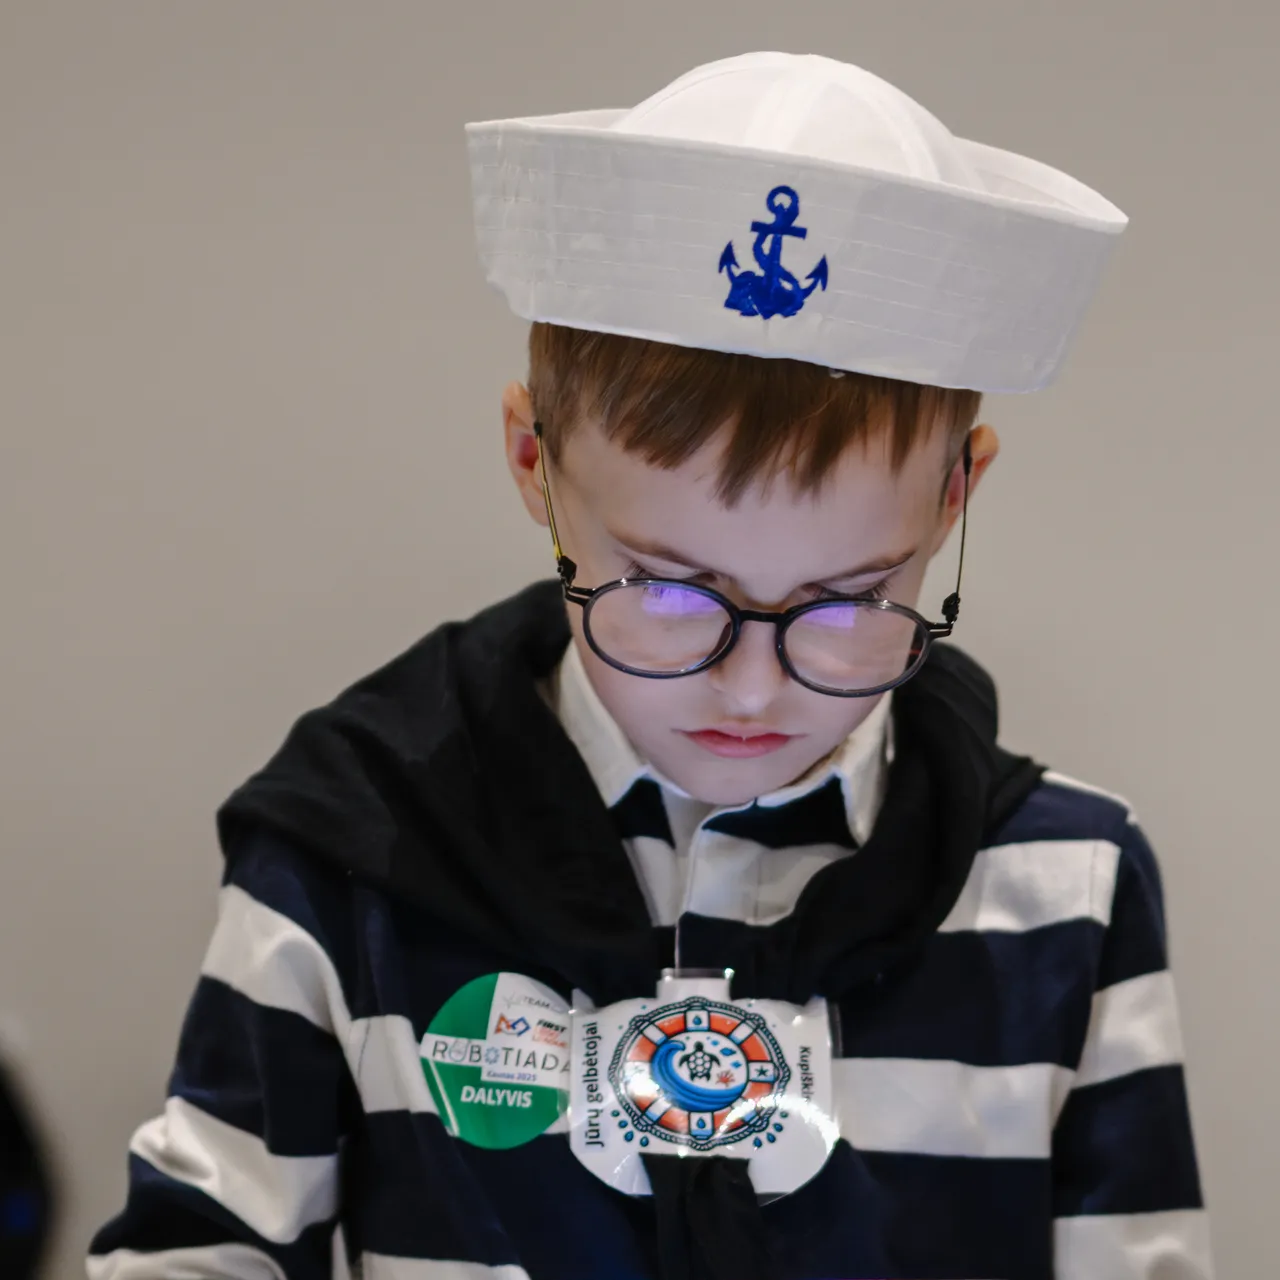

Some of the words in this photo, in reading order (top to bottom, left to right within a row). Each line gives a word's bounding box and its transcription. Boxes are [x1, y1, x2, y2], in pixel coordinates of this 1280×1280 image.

[536, 1019, 567, 1034] FIRST
[582, 1021, 604, 1103] gelbėtojai
[460, 1085, 533, 1108] DALYVIS
[584, 1108, 605, 1148] Jūrų
